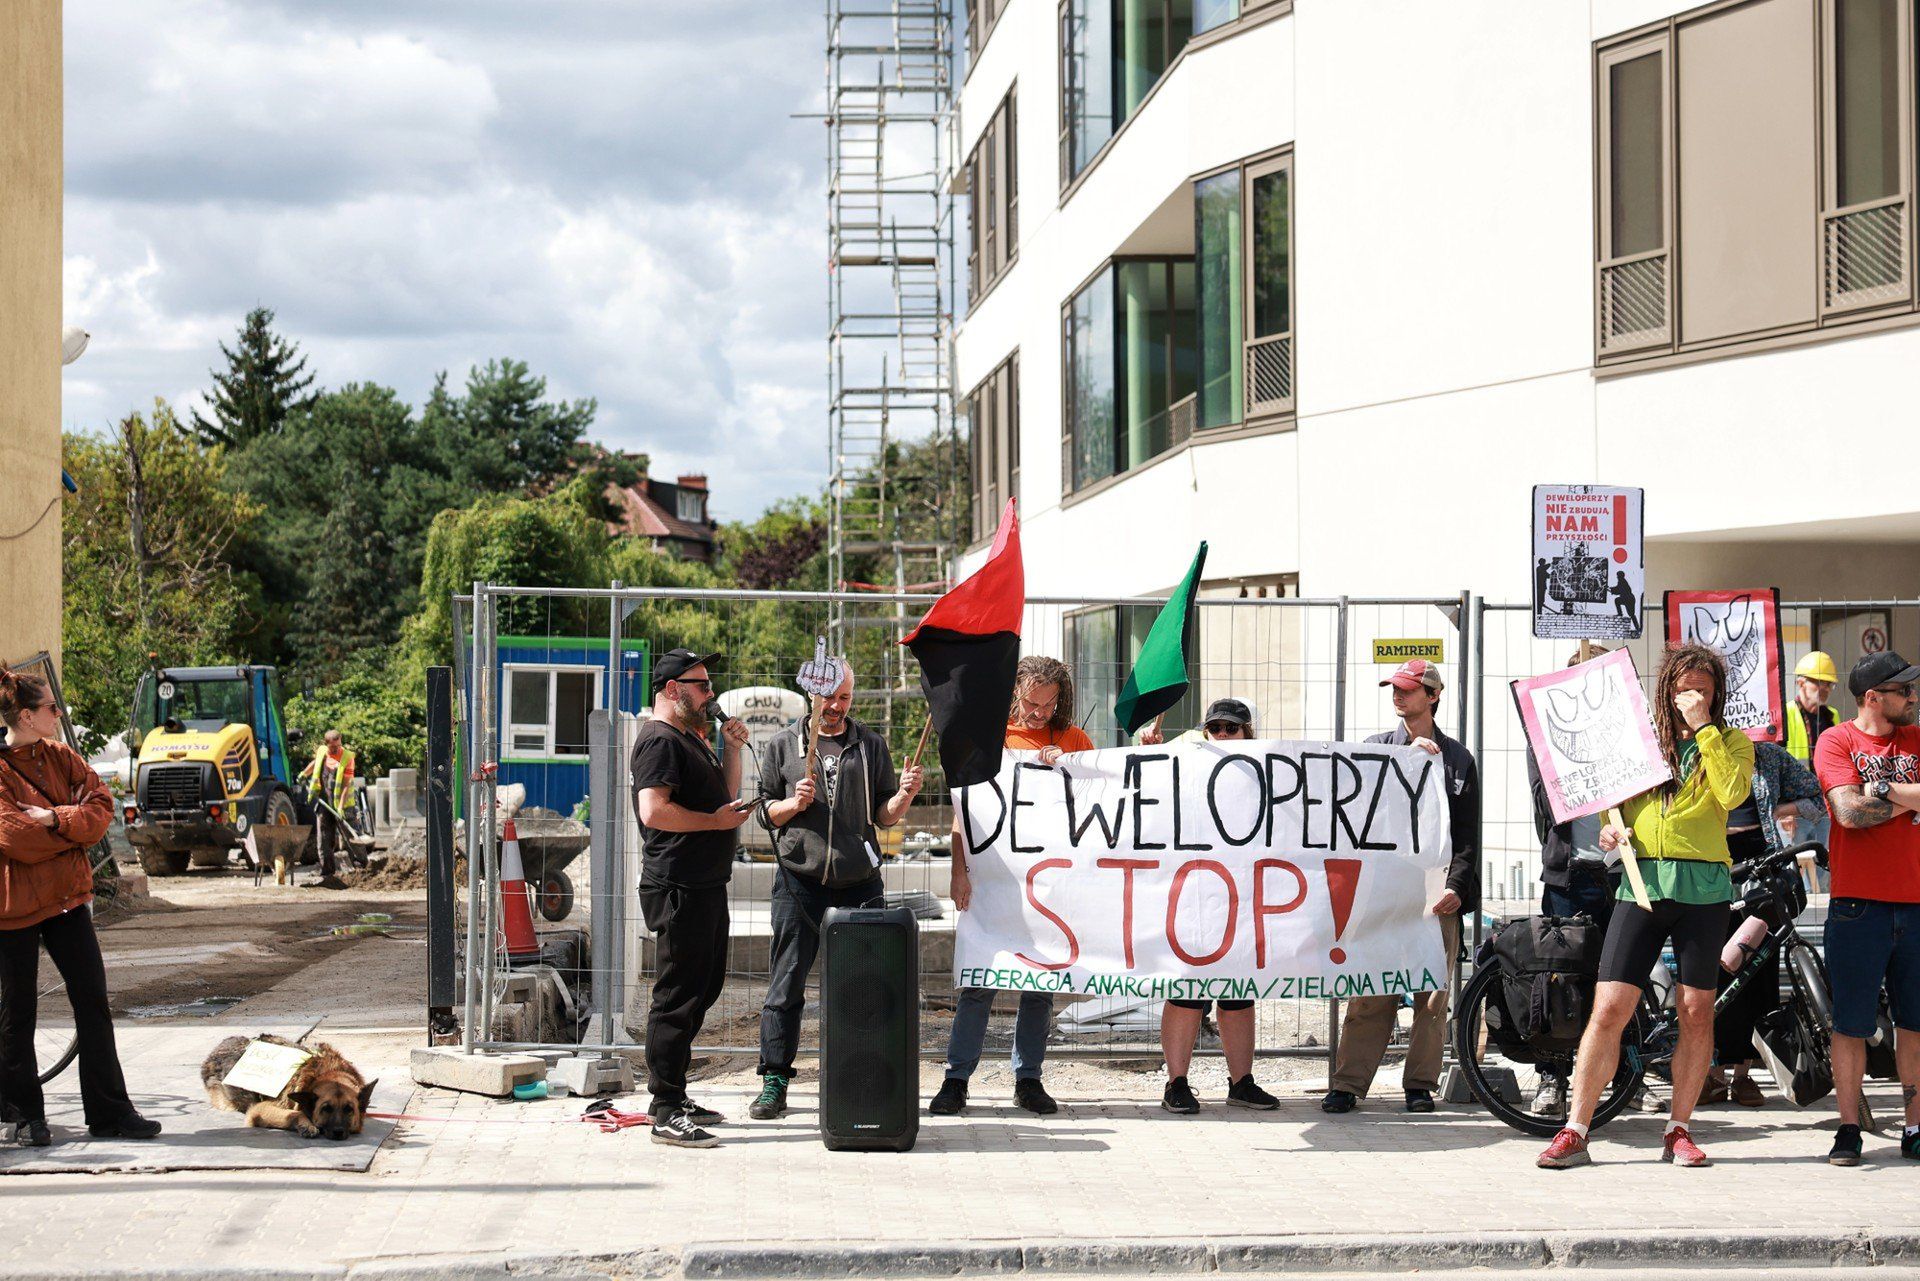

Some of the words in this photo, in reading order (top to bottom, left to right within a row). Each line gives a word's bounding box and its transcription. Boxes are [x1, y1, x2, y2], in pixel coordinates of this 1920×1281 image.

[1546, 494, 1609, 502] DEWELOPERZY
[1545, 504, 1567, 514] NIE
[1545, 515, 1599, 532] NAM
[1376, 645, 1440, 656] RAMIRENT
[162, 685, 172, 696] 20
[151, 743, 210, 752] KOMATSU
[961, 753, 1433, 855] DEWELOPERZY
[1562, 794, 1589, 814] NAM
[1014, 857, 1362, 971] STOP!
[959, 968, 1074, 992] FEDERACJA
[1382, 967, 1439, 994] FALA
